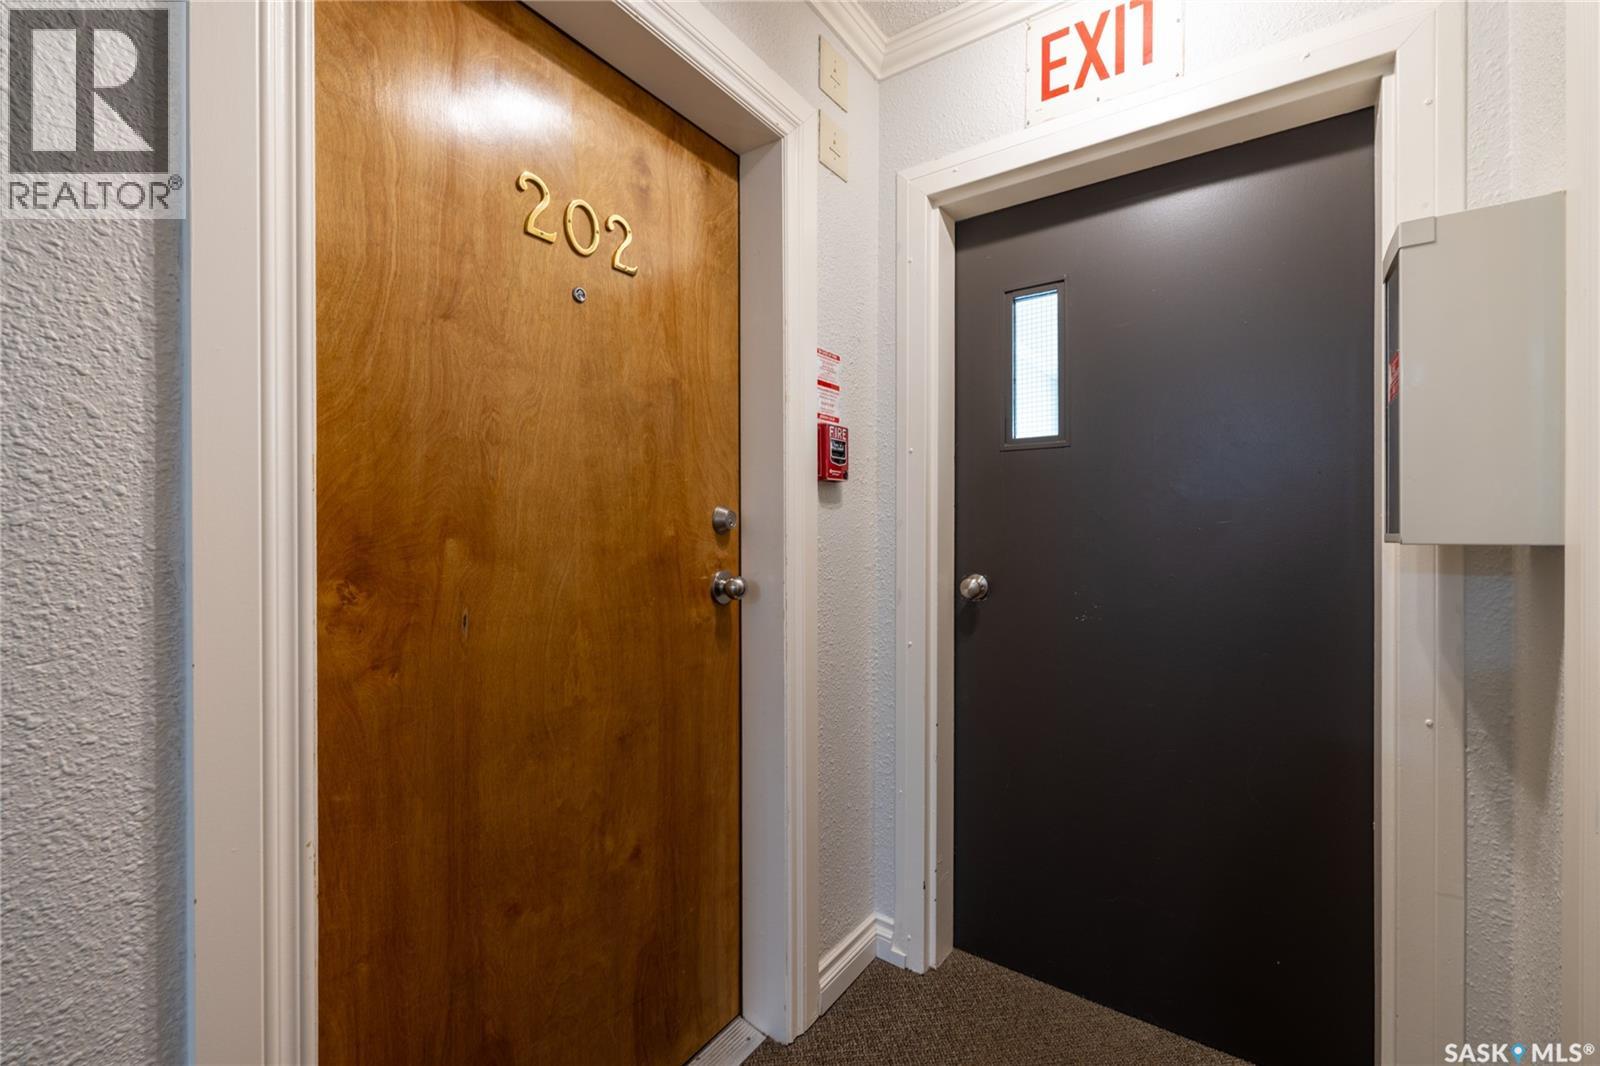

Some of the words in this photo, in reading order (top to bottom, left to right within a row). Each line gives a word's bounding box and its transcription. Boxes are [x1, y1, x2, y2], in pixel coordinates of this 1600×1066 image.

[1041, 0, 1154, 102] EXIT
[516, 170, 638, 277] 202
[830, 426, 847, 440] FIRE
